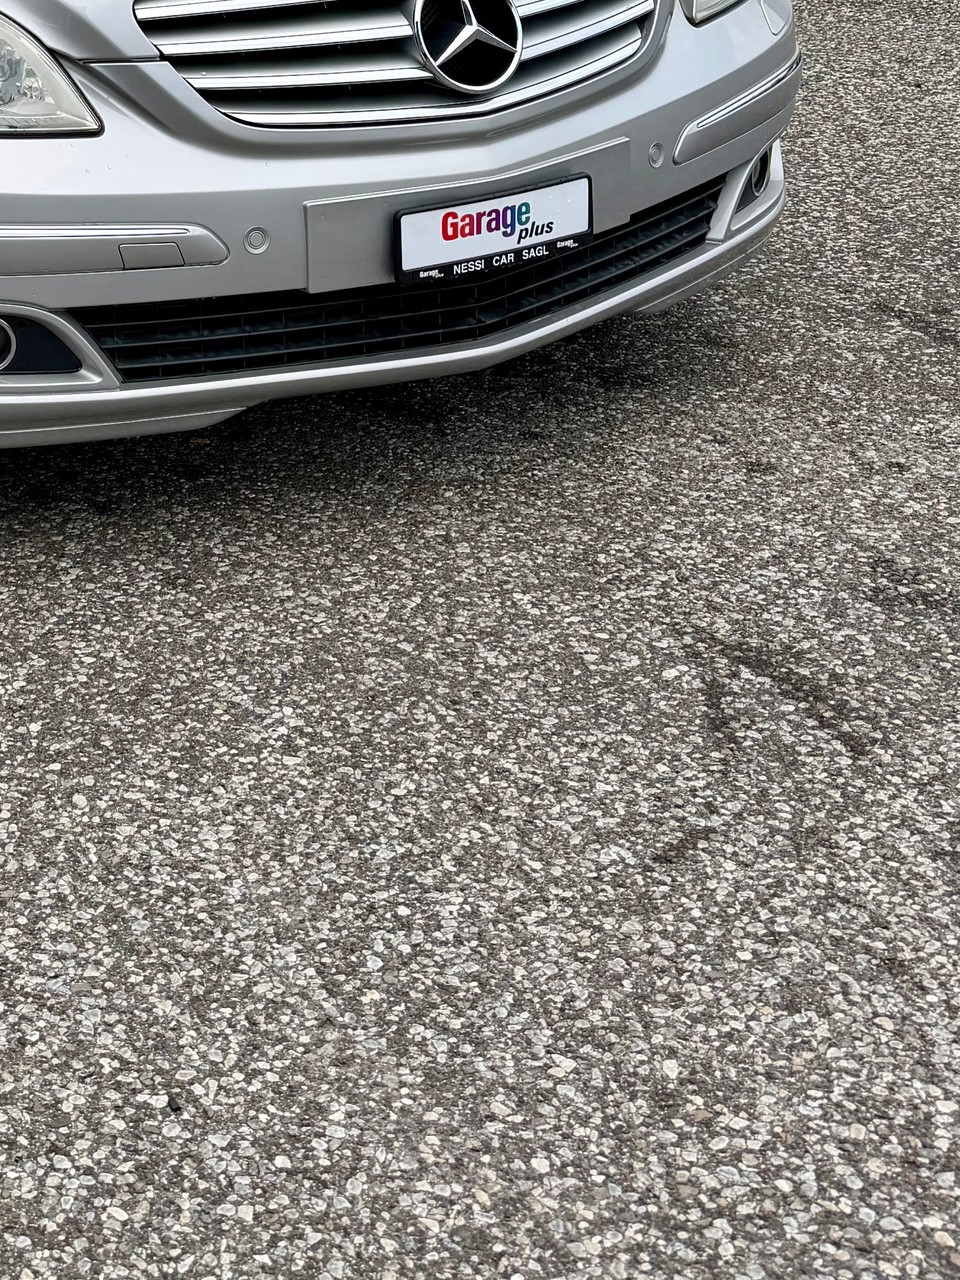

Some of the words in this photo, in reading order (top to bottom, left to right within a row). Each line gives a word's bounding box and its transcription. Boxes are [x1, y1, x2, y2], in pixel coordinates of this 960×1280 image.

[441, 201, 531, 241] Garage
[516, 221, 554, 244] plus
[453, 260, 485, 275] NESSI
[492, 253, 515, 267] CAR
[522, 245, 549, 260] SAGL
